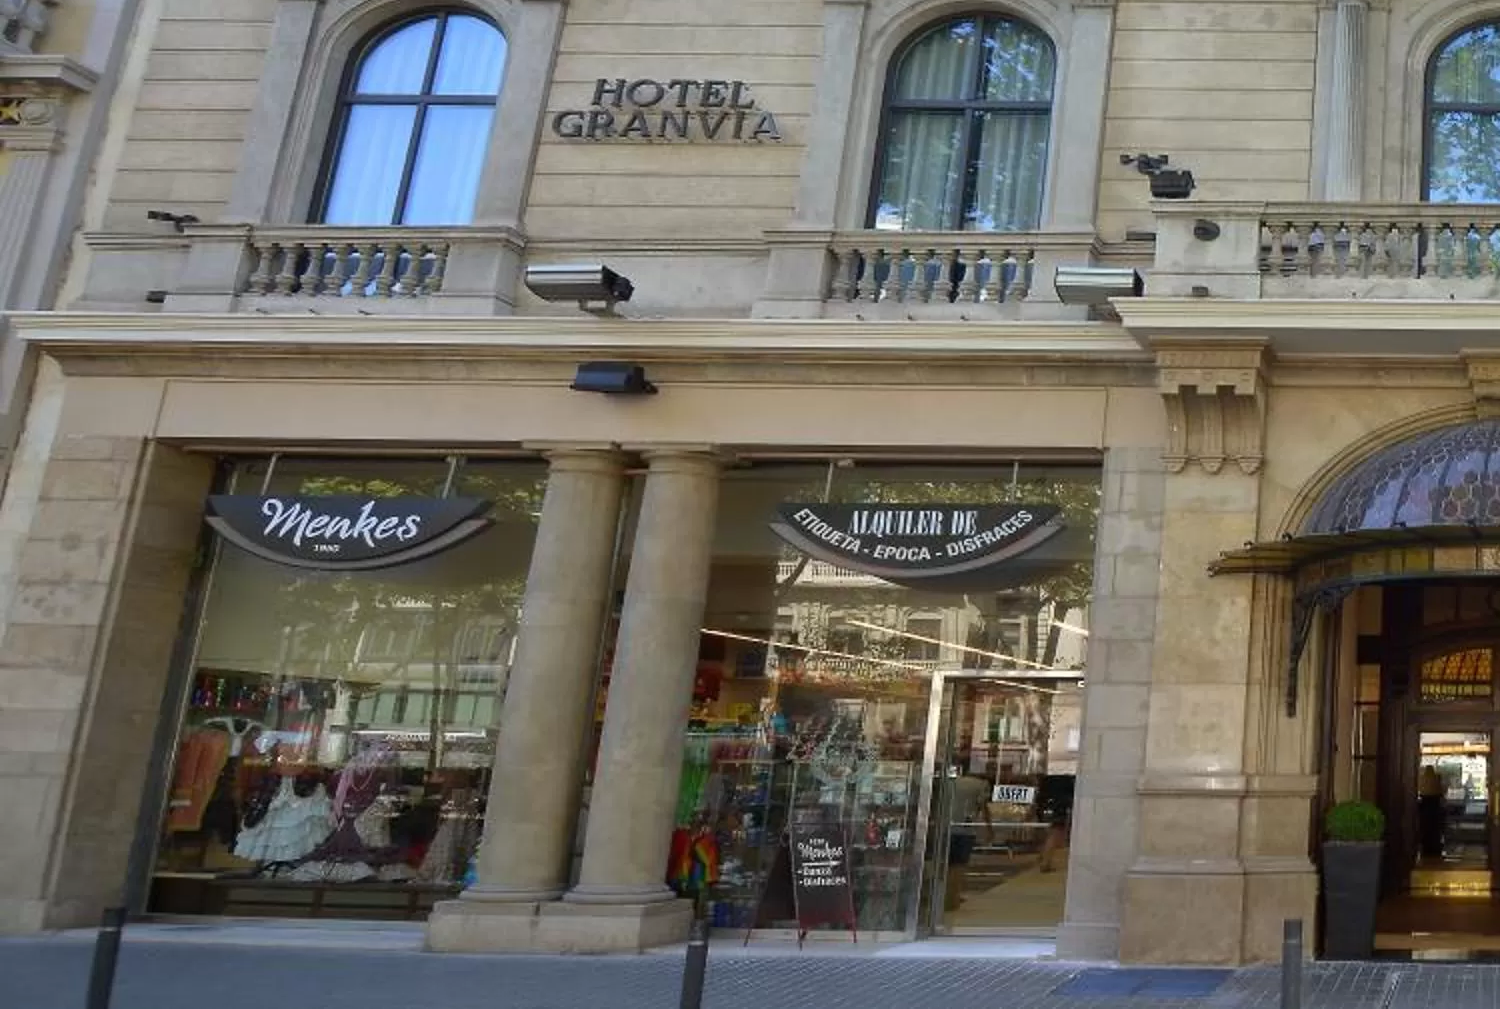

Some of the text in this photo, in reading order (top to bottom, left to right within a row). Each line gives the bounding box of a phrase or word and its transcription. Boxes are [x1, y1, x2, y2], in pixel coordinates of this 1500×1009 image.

[591, 78, 755, 109] HOTEL
[552, 109, 782, 141] GRANVIA
[262, 498, 421, 547] Menkes
[793, 507, 862, 553] ETIQUETA
[873, 544, 932, 561] EPOCA
[945, 510, 1033, 557] DISFRACES
[848, 510, 979, 538] ALQUILER DE
